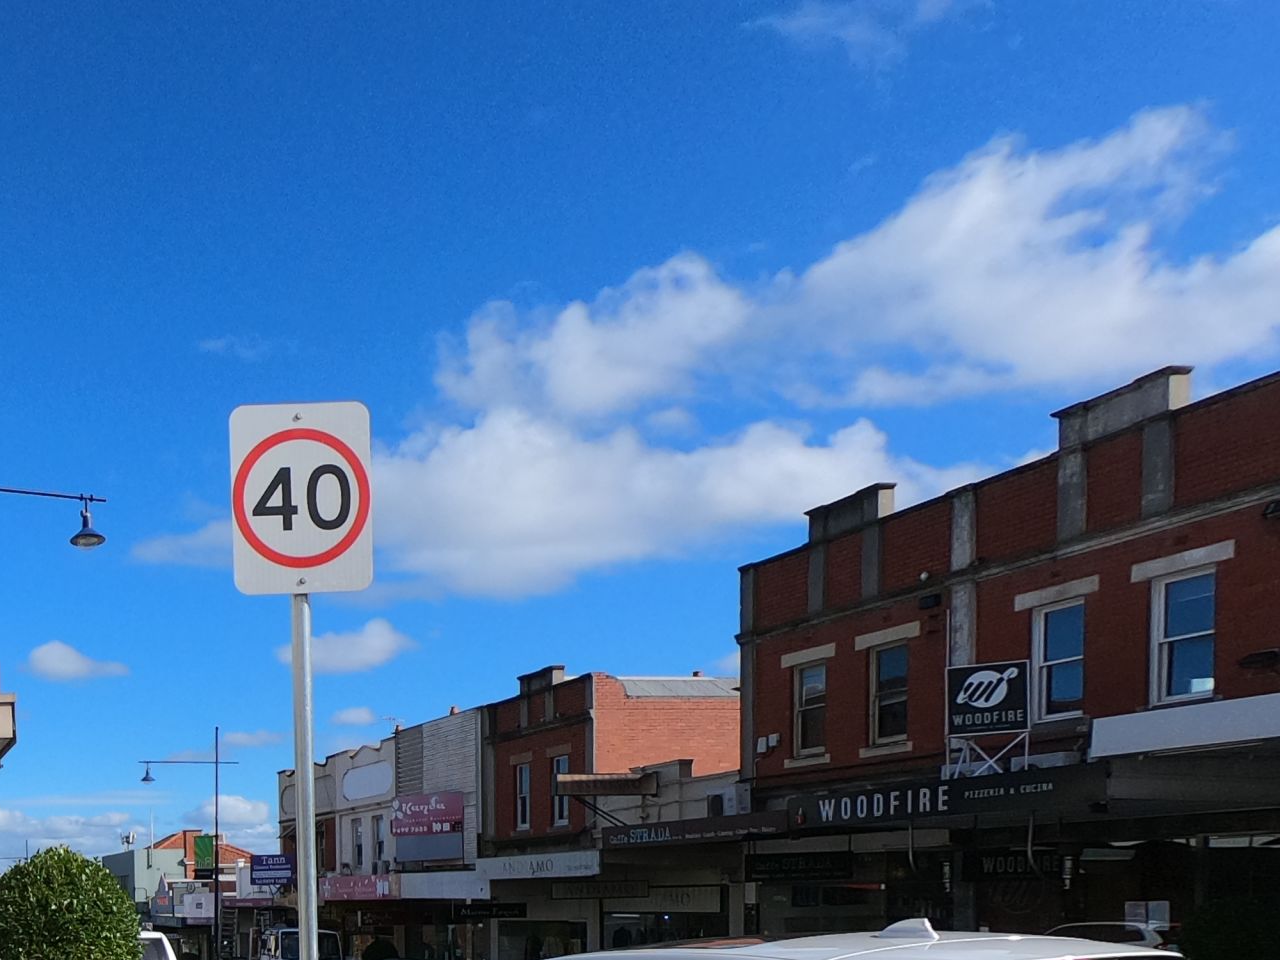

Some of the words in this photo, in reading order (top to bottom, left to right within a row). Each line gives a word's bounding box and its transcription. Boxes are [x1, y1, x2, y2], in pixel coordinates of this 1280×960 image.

[252, 463, 351, 531] 40
[952, 709, 1025, 726] WOODFIRE
[819, 785, 949, 822] WOODFIRE
[629, 826, 672, 843] STRADA
[260, 856, 286, 865] Tann
